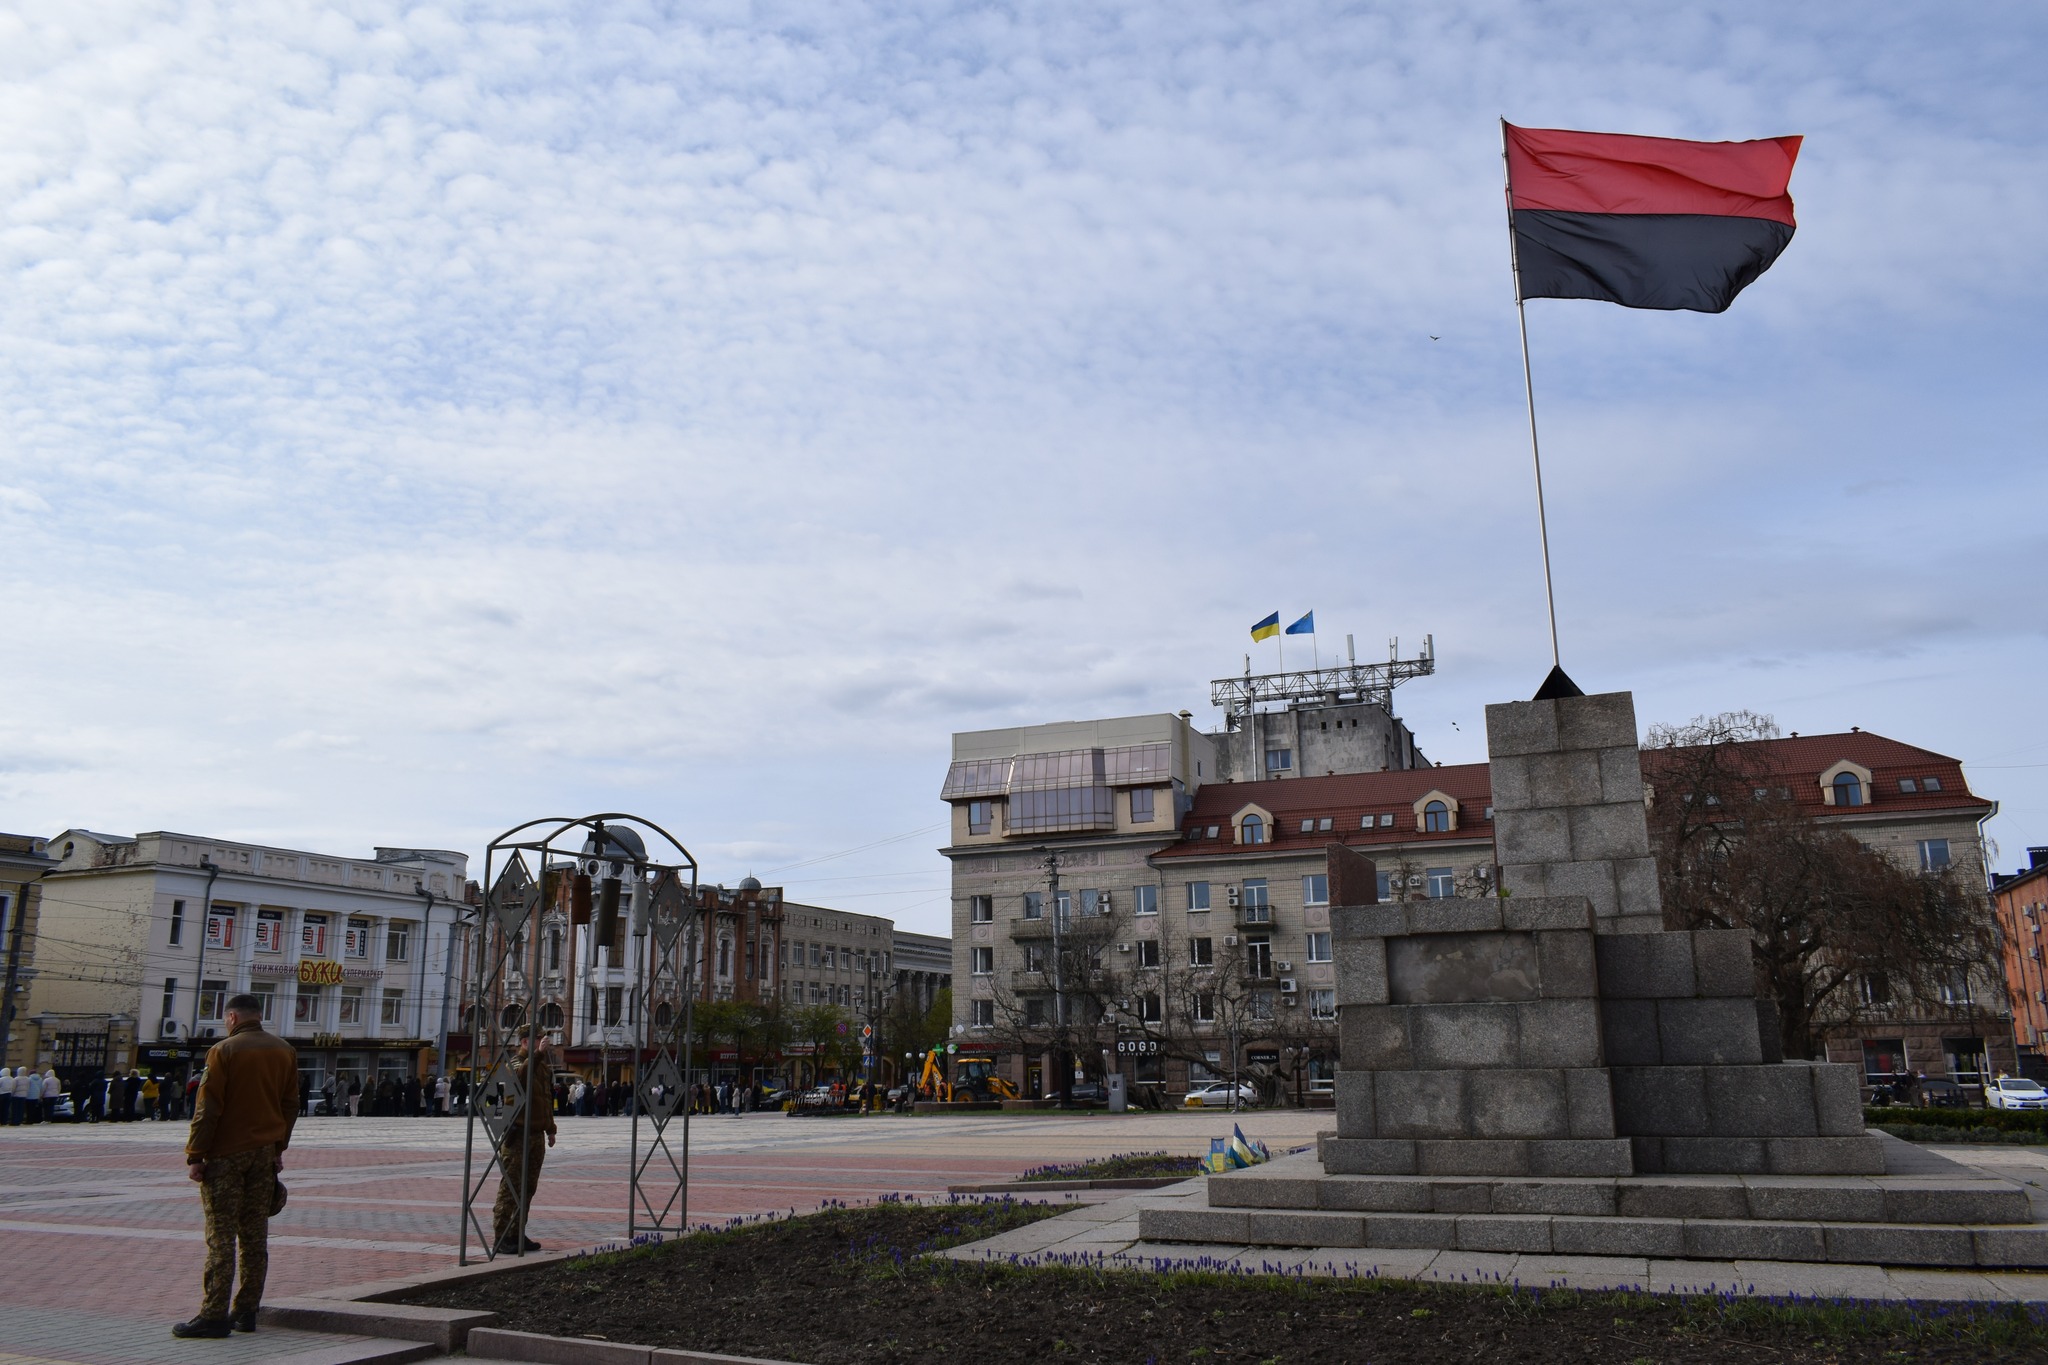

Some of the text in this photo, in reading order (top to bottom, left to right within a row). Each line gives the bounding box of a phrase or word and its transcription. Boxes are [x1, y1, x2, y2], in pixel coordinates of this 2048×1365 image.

[252, 960, 384, 983] КНИЖКОВИЙ БУКИ СУПЕРМАРКЕТ
[313, 1032, 342, 1047] VIVA
